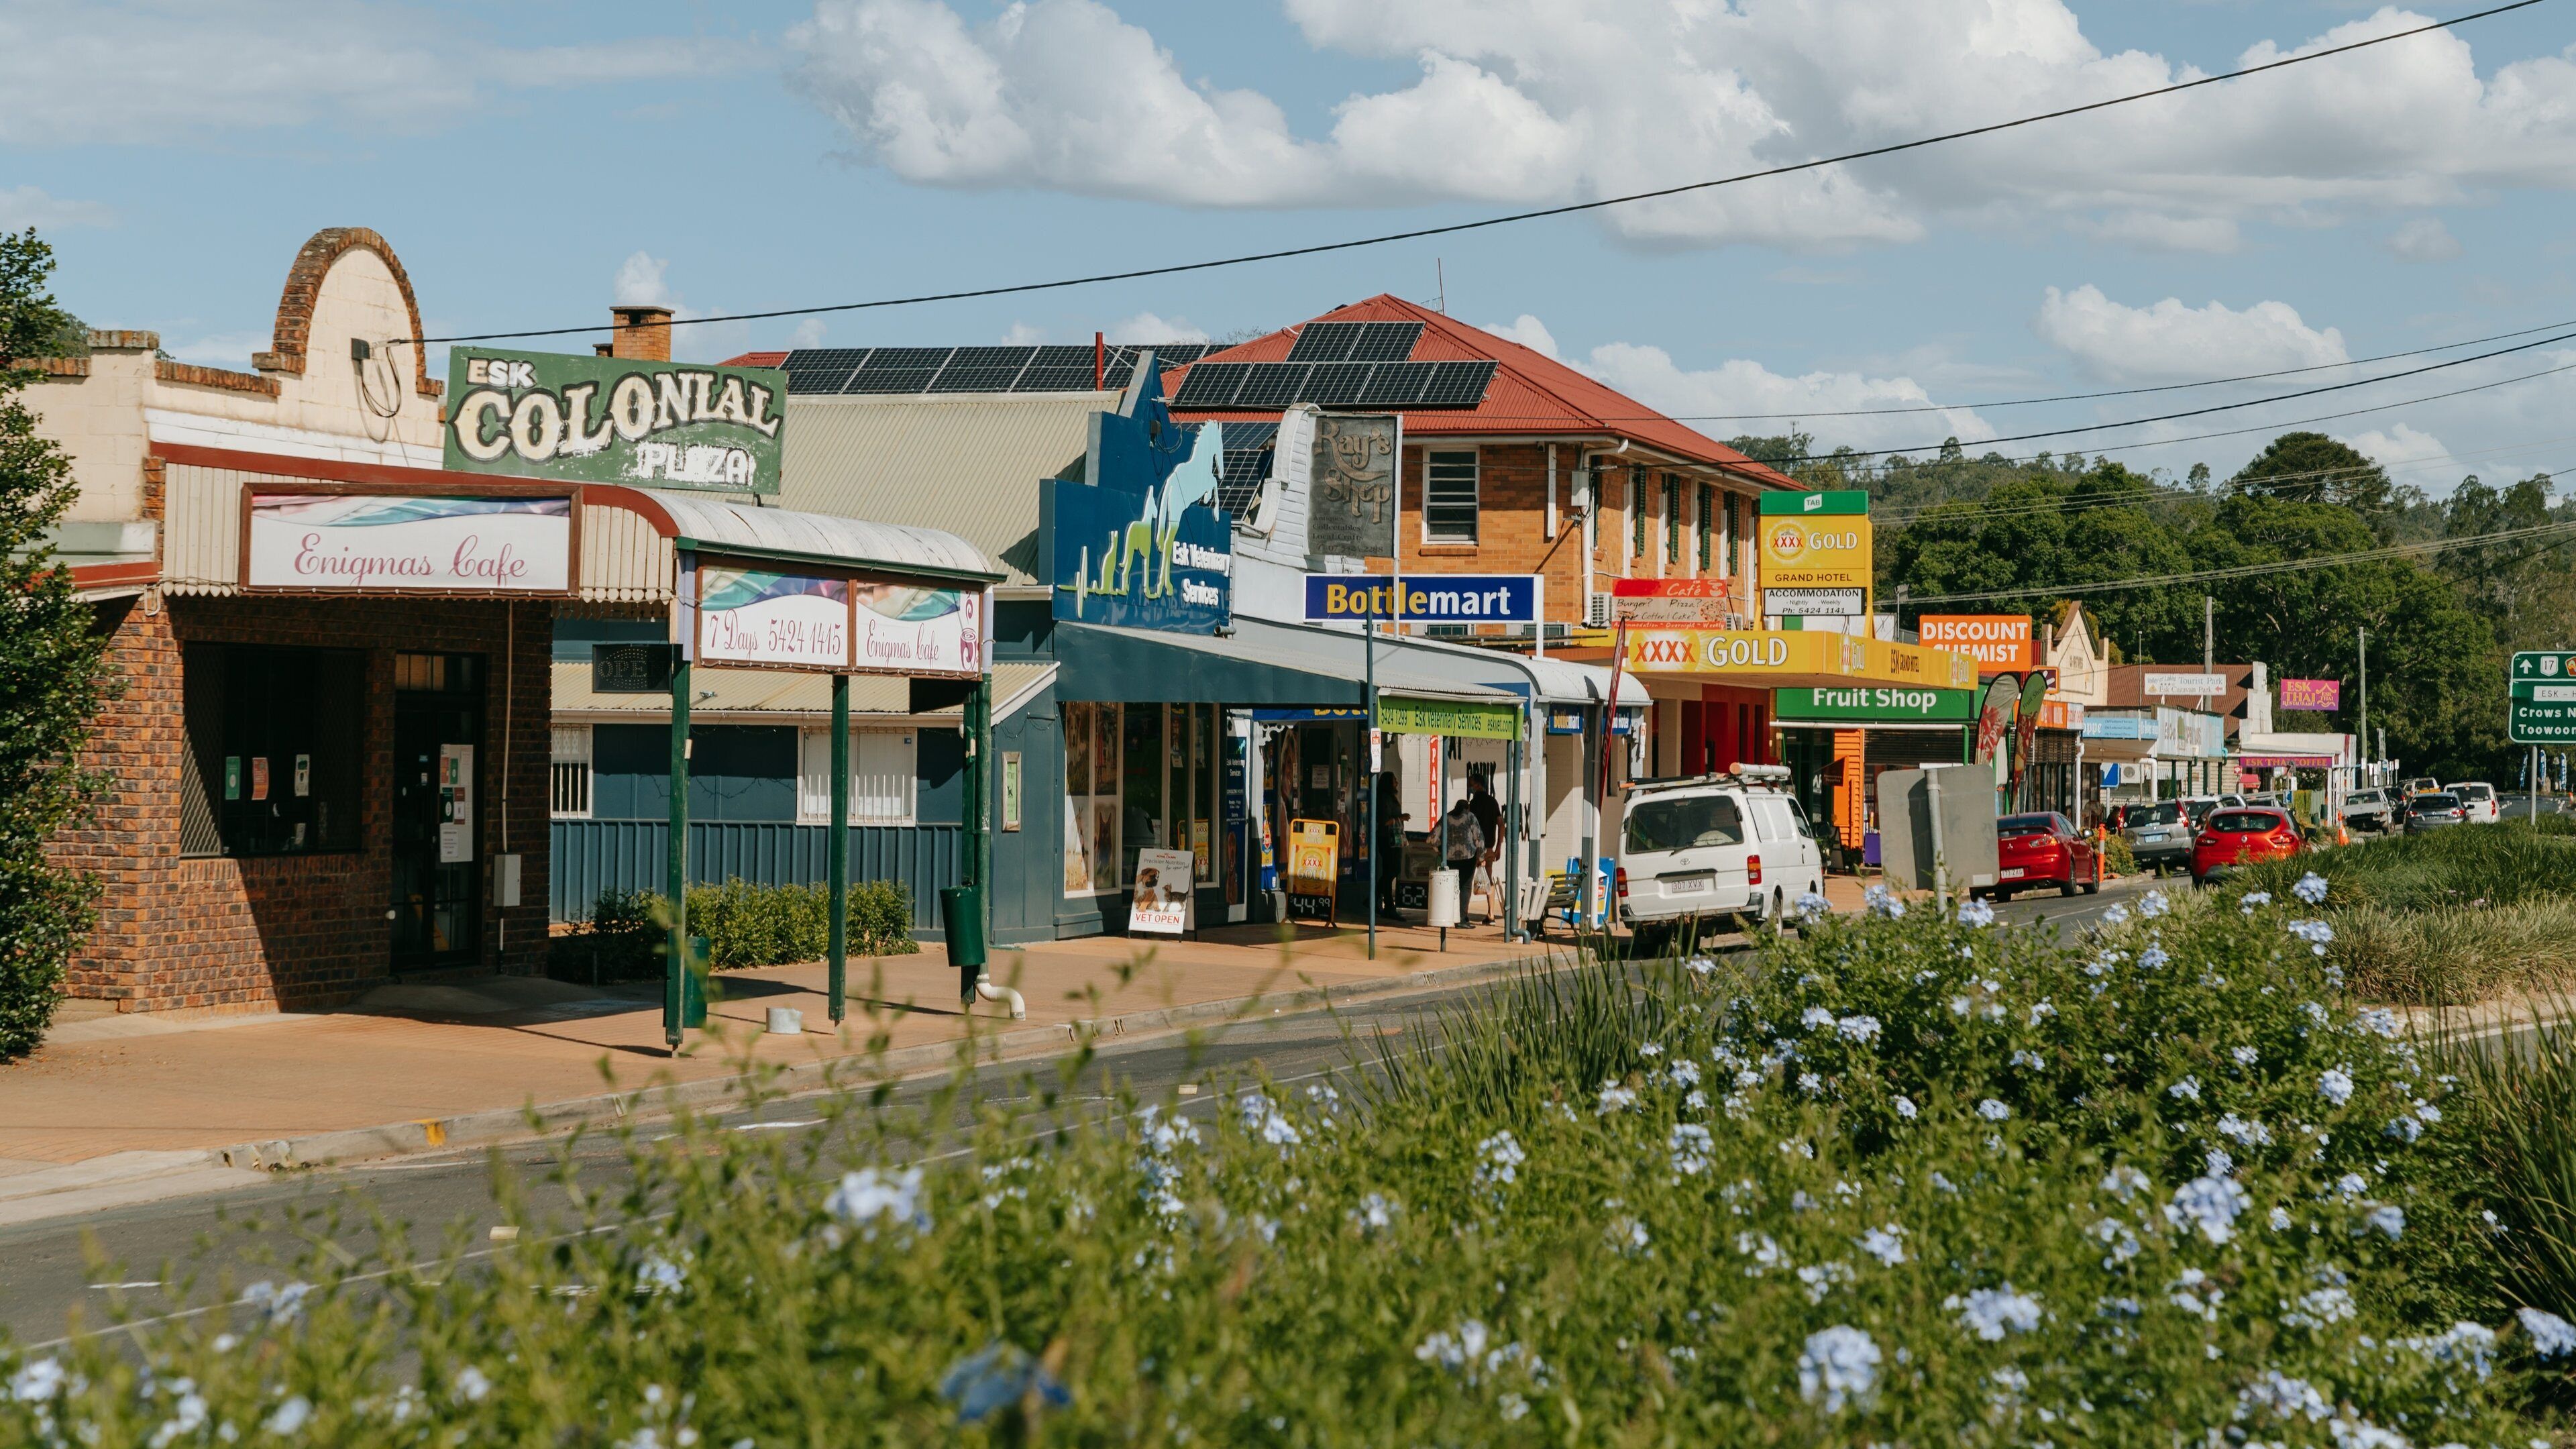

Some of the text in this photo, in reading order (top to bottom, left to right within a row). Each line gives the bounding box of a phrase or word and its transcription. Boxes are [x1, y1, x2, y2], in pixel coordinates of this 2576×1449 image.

[468, 357, 537, 388] ESK
[451, 368, 784, 464] COLONIAL
[1313, 420, 1391, 482] Ray's
[1324, 468, 1391, 524] Shop
[1773, 532, 1858, 550] XXXX GOLD
[294, 533, 528, 586] Enigmas Cafe
[1173, 541, 1189, 566] Esk
[1775, 574, 1852, 582] GRAND HOTEL
[1183, 578, 1219, 606] Services
[1666, 582, 1701, 596] Café
[1328, 582, 1511, 615] Bottlemart
[1617, 598, 1703, 610] Burger? Pizza?
[710, 608, 841, 659] 7 Days 5424 1415
[1666, 622, 1695, 630] Overnight
[1923, 622, 2028, 641] DISCOUNT
[867, 619, 940, 669] Enigmas Cafe
[1634, 636, 1788, 667] XXXX GOLD
[1933, 644, 2019, 662] EMIST
[598, 661, 648, 678] OPE
[1891, 649, 1899, 674] ESK
[2544, 661, 2554, 670] 17
[2179, 676, 2203, 684] Tourist
[2288, 682, 2311, 692] ESK
[1813, 688, 1937, 714] Fruit Shop
[2283, 692, 2316, 702] THAI
[1381, 707, 1394, 724] 5424
[1395, 708, 1407, 726] 1299
[1415, 705, 1426, 727] Esk
[1428, 708, 1456, 734] Veterinary
[1458, 708, 1481, 731] Services
[1487, 717, 1513, 733] eskvet.com
[1554, 709, 1579, 729] Bottlemart
[2519, 707, 2561, 718] Crows
[1302, 859, 1322, 867] XXXX
[1297, 867, 1326, 880] GOLD
[1688, 879, 1703, 889] XVX
[1135, 913, 1180, 924] VET OPEN
